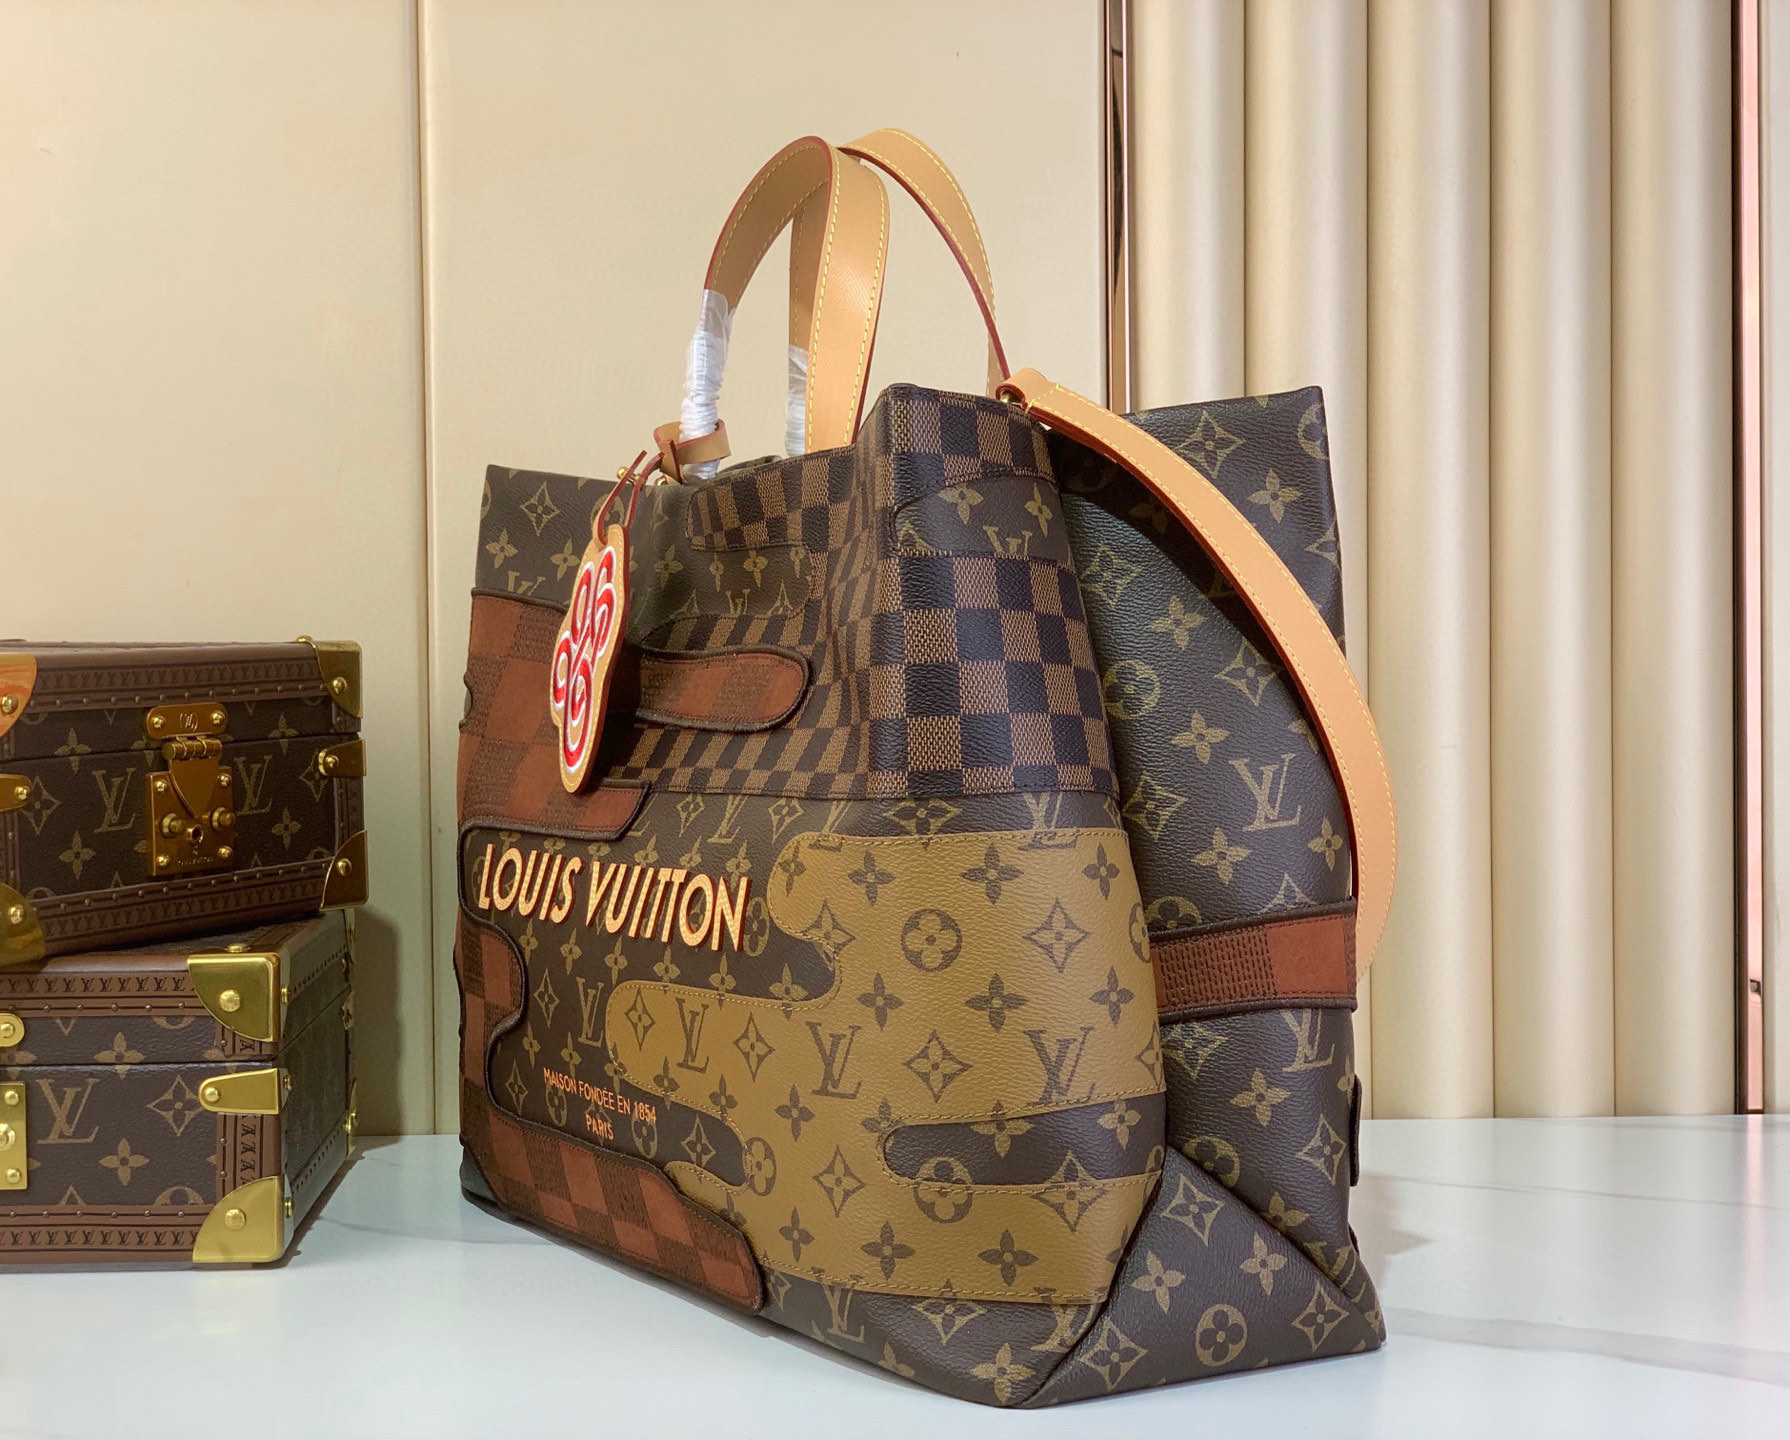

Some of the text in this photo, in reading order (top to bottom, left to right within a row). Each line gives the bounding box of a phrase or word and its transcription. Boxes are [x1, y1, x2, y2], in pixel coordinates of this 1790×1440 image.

[479, 843, 750, 952] LOUIS VUITTON
[543, 1067, 577, 1094] MAISON
[617, 1095, 631, 1114] EN
[633, 1101, 657, 1123] 1854
[585, 1114, 614, 1140] PARIS
